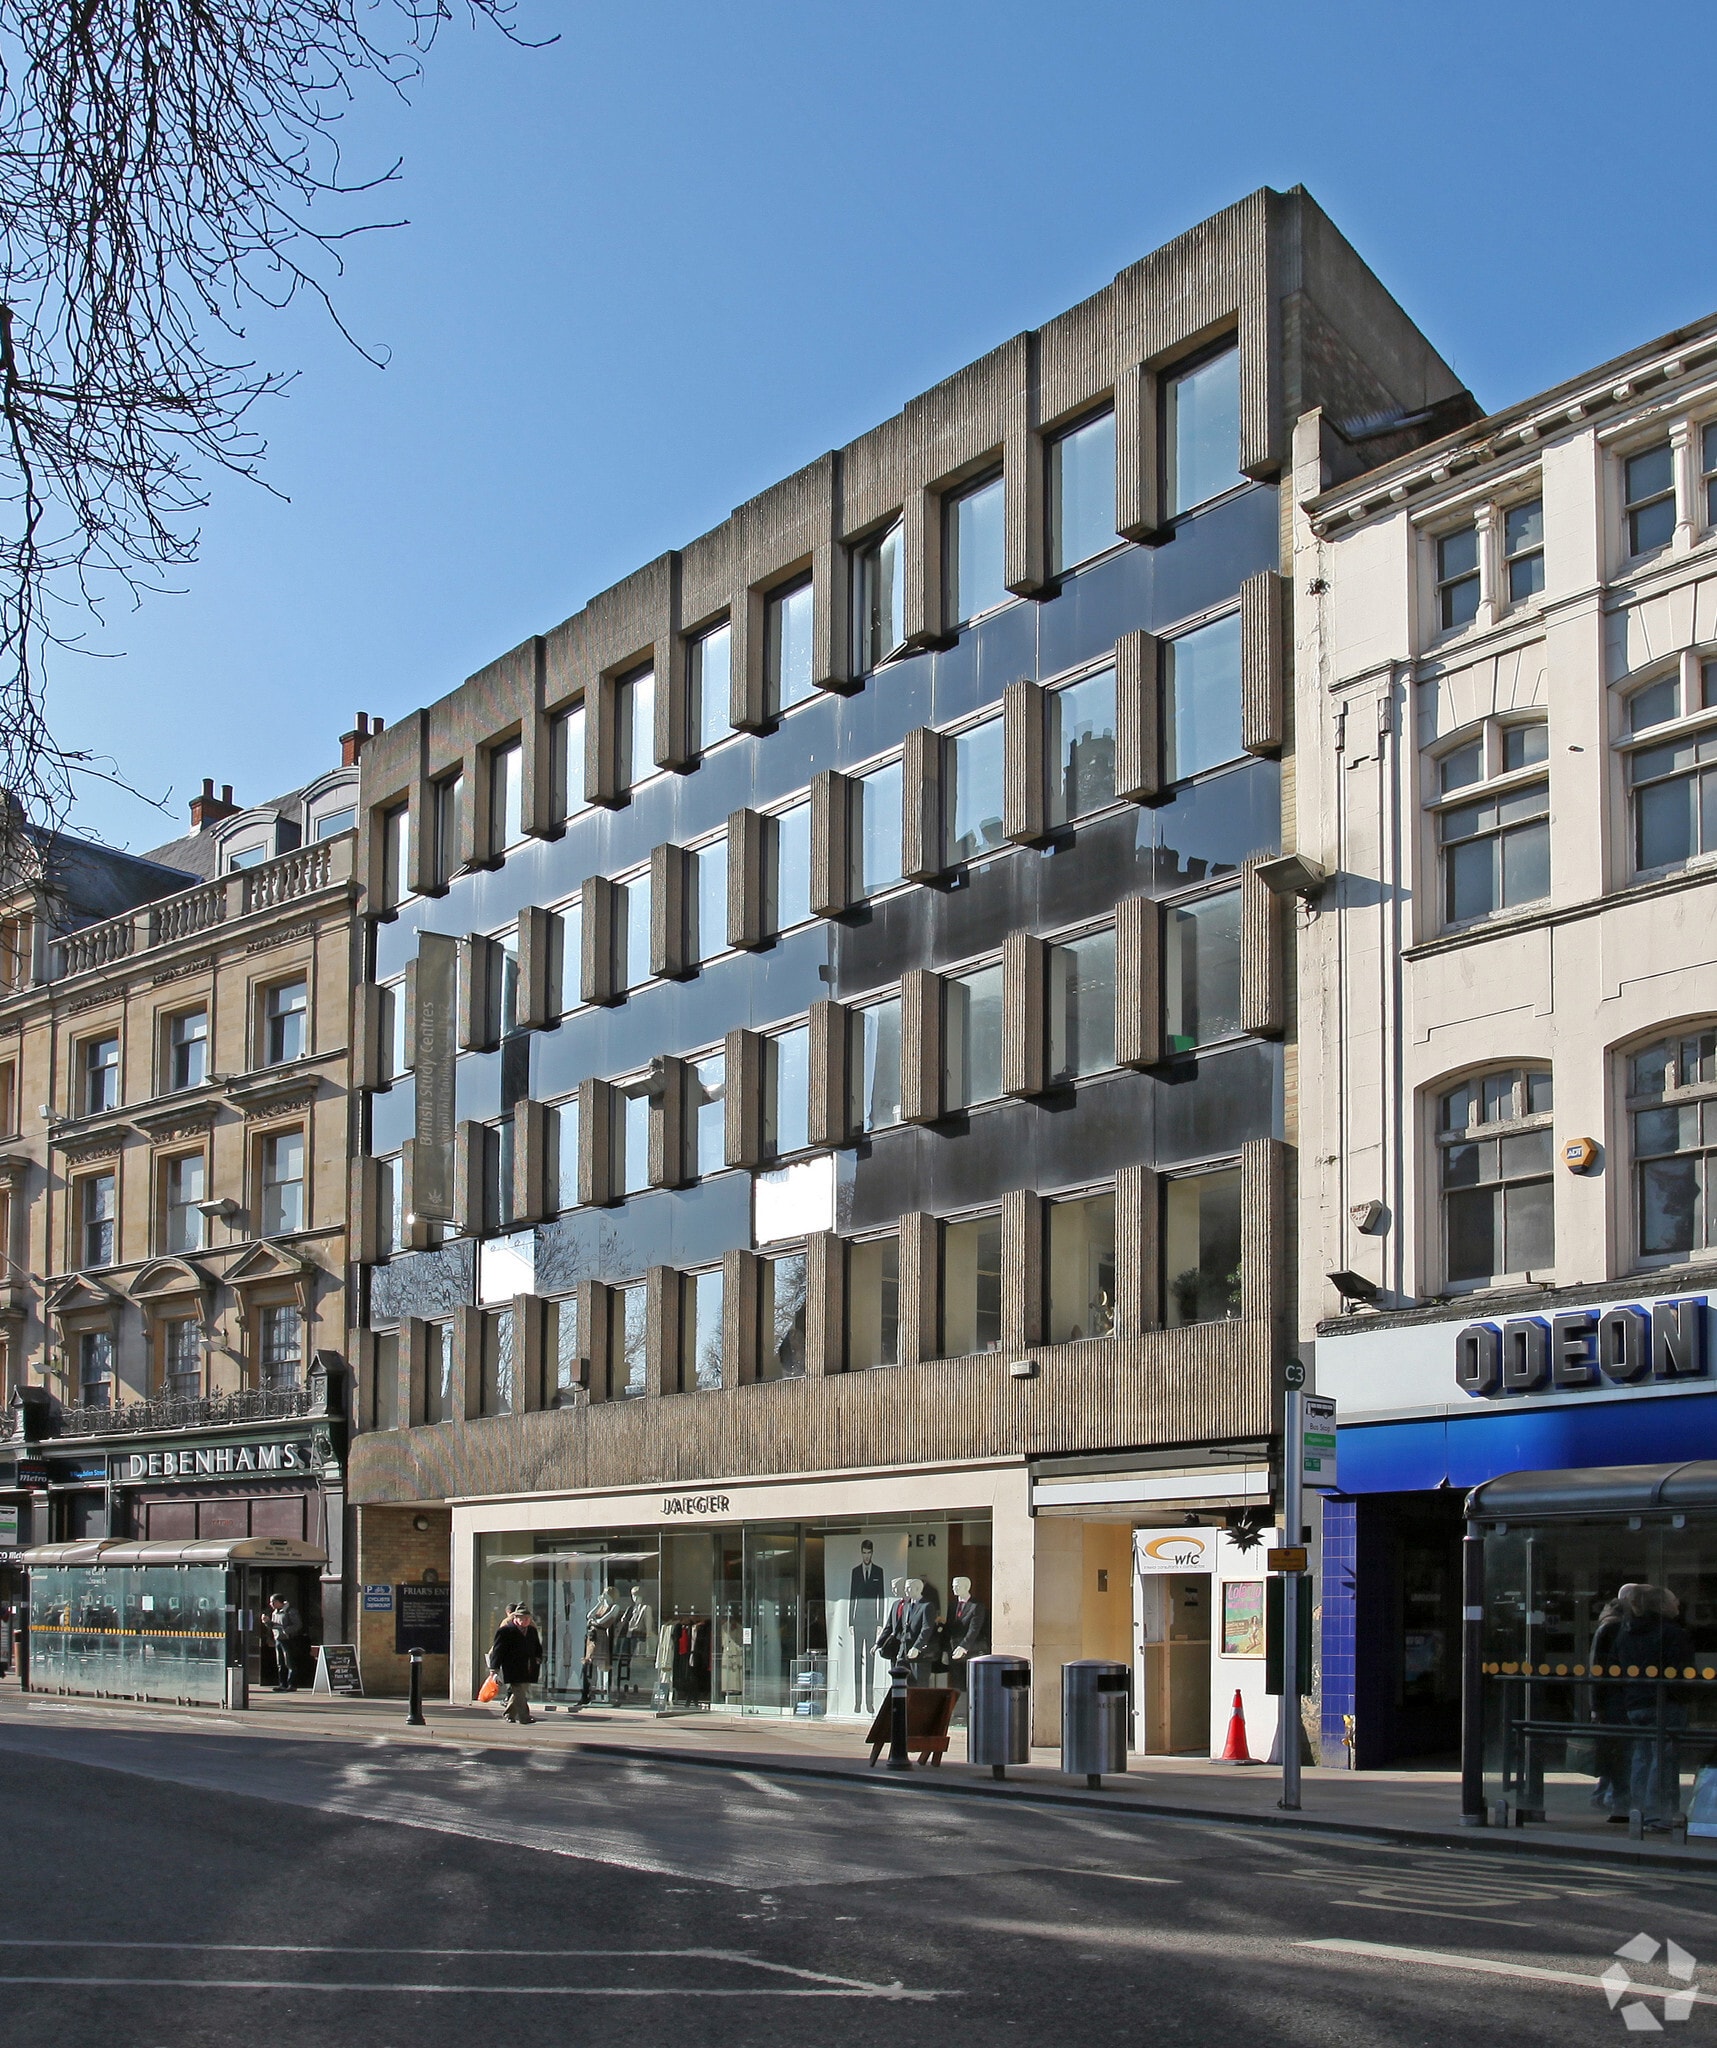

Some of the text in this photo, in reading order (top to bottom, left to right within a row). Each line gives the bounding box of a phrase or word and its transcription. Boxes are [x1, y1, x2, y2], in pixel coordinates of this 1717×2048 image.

[419, 1003, 437, 1146] British Study Centres
[1567, 1147, 1582, 1158] ADT
[1456, 1297, 1706, 1397] ODEON
[1285, 1365, 1304, 1383] C3
[1309, 1422, 1331, 1433] Bus Stop
[129, 1443, 299, 1477] DEBENHAMS
[19, 1474, 48, 1483] Metro
[660, 1495, 730, 1515] JAEGER
[1175, 1552, 1200, 1565] wfc
